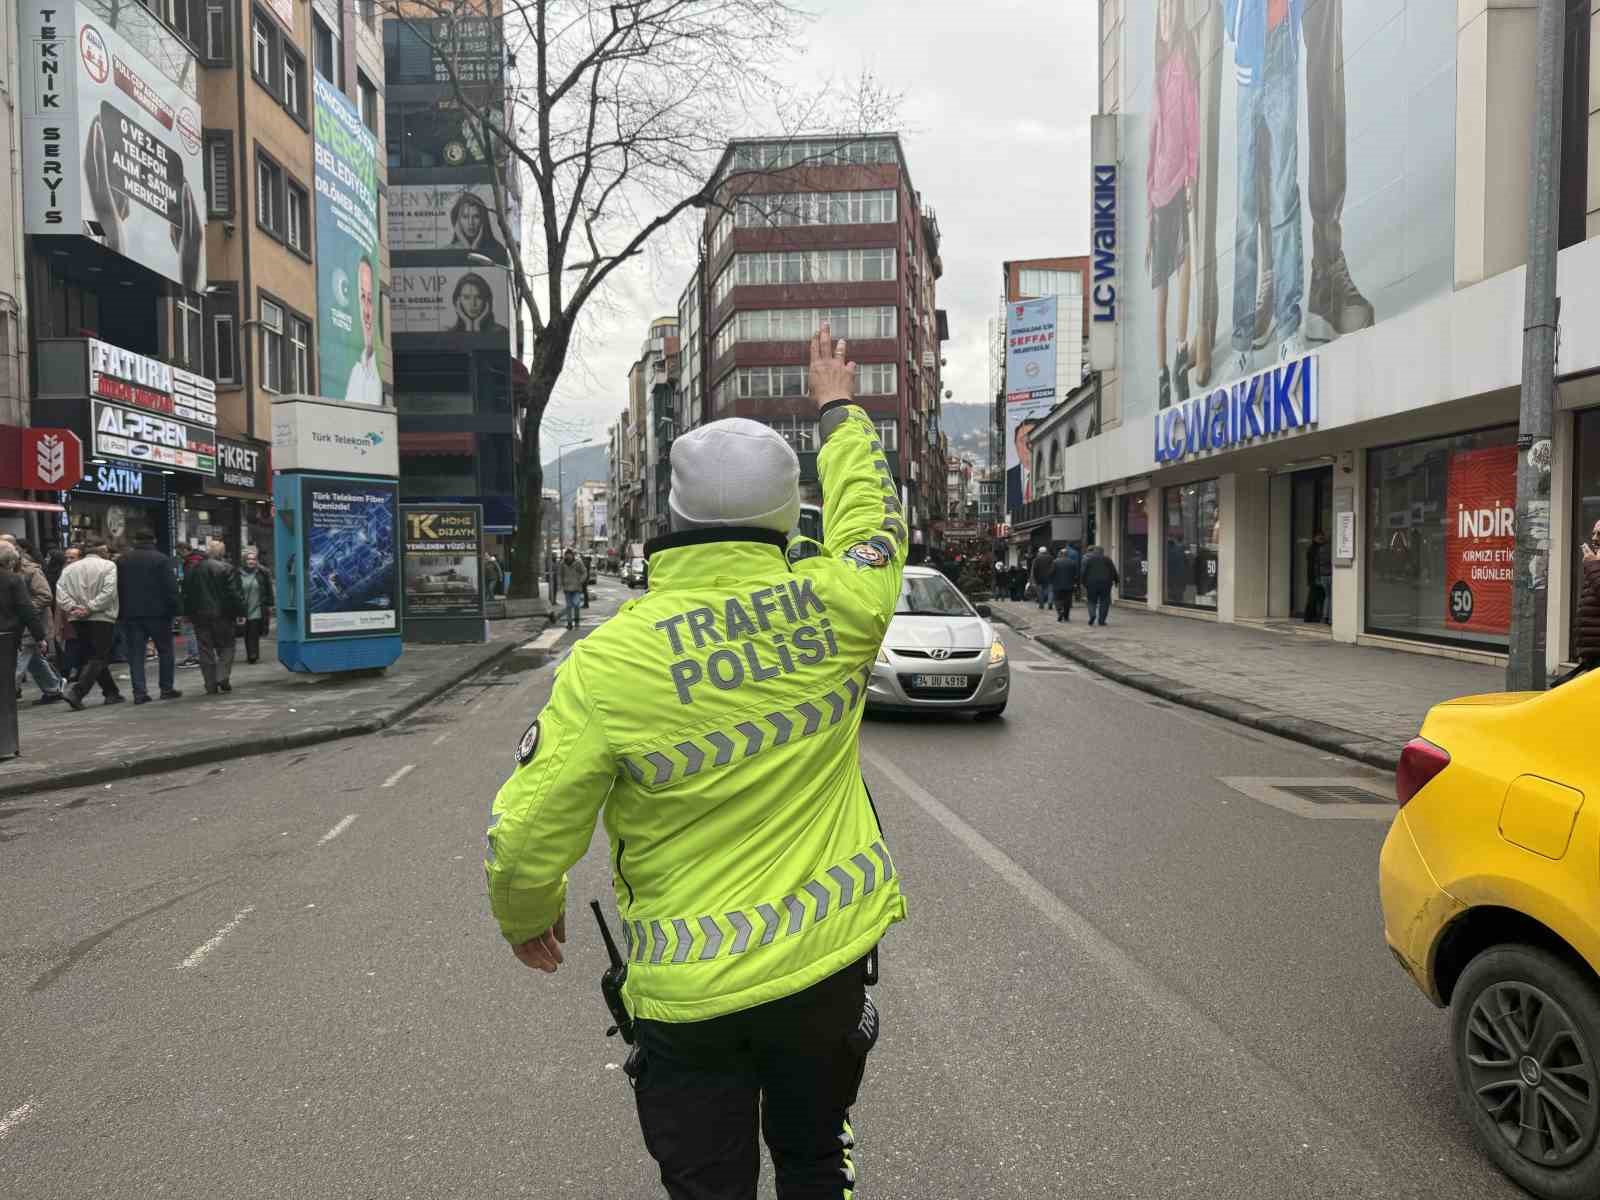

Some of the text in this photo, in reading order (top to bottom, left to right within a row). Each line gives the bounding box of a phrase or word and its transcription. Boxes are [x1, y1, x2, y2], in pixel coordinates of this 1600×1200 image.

[122, 137, 168, 180] TELEFON
[130, 123, 145, 146] VE
[156, 143, 168, 164] EL
[113, 150, 140, 179] ALIM
[147, 172, 177, 203] SATIM
[124, 175, 168, 215] MERKEZİ
[99, 342, 174, 394] FATURA
[97, 405, 187, 450] ALPEREN
[312, 431, 370, 447] Türk Telekom
[97, 466, 143, 495] SATIM
[438, 528, 476, 537] DİZAYN
[441, 517, 472, 526] HOME
[1463, 549, 1493, 561] KIRMIZI
[1452, 590, 1471, 611] 50
